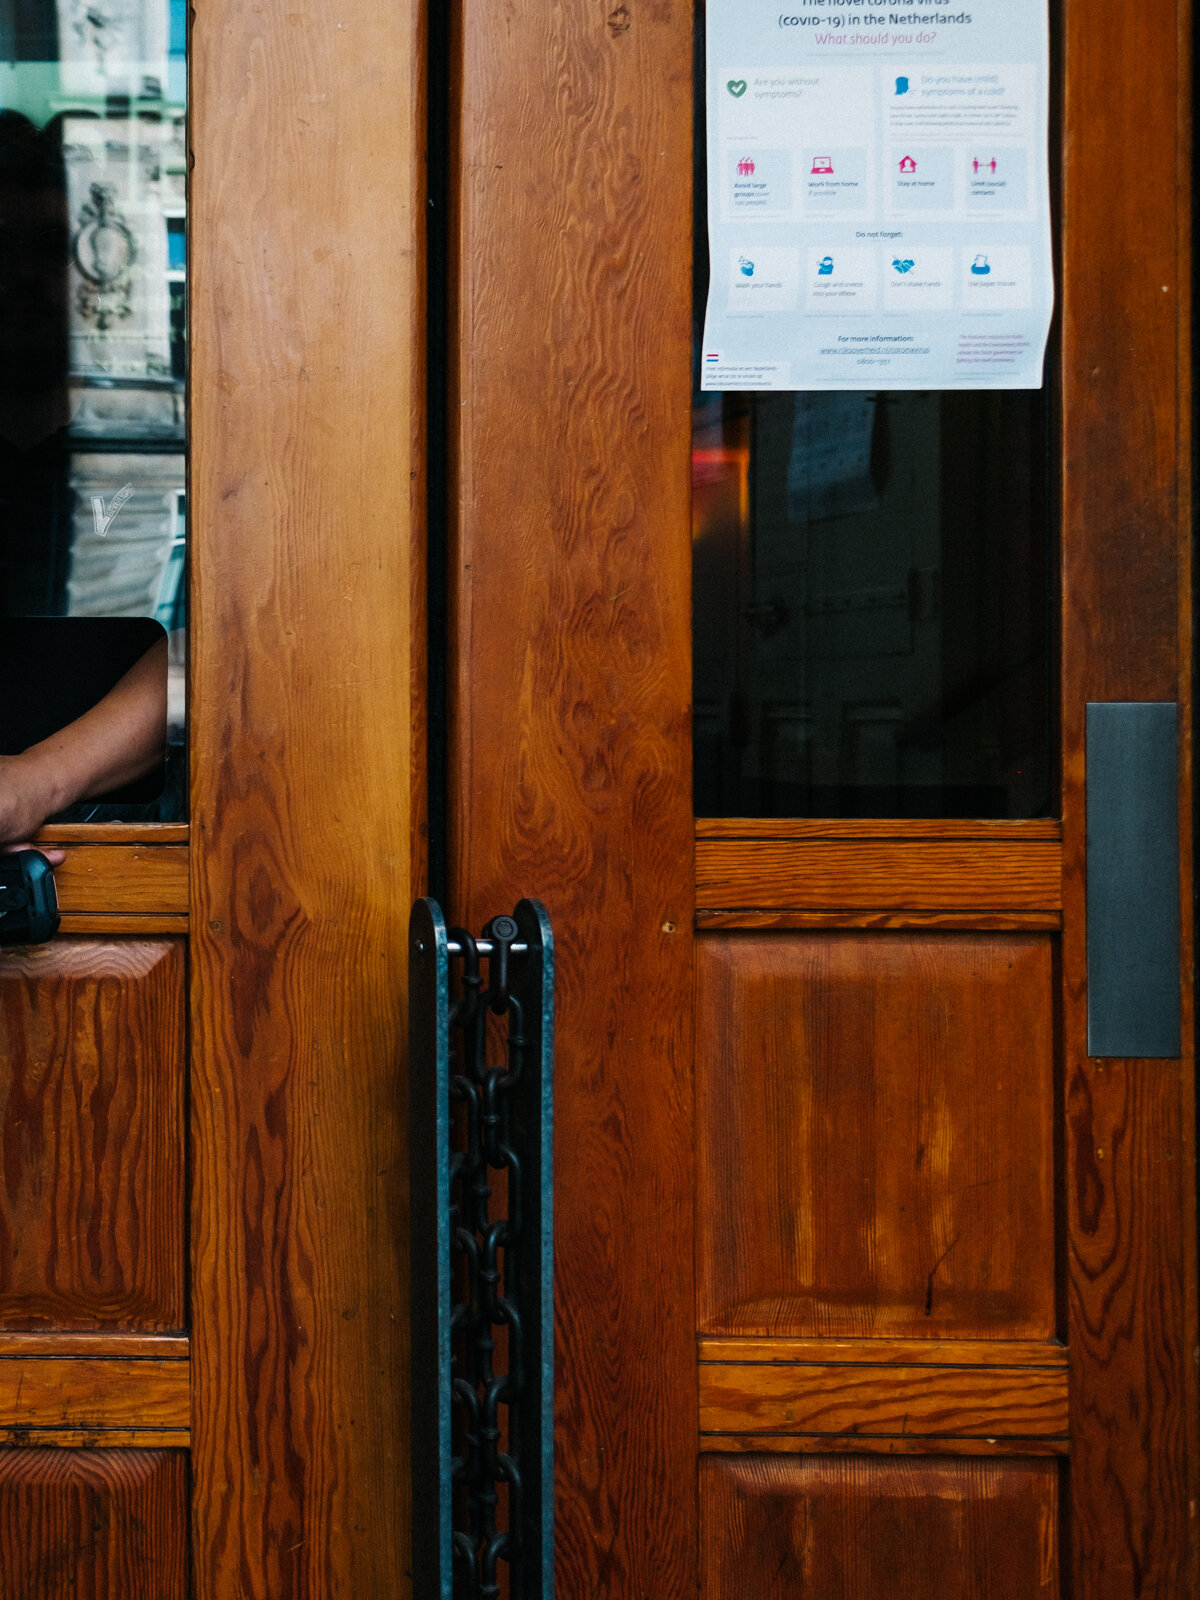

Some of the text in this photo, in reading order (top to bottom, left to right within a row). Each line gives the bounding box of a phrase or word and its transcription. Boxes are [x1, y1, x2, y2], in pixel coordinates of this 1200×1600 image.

[848, 14, 860, 25] in
[863, 14, 885, 25] the
[889, 12, 972, 25] Netherlands
[815, 32, 937, 46] What should you do?
